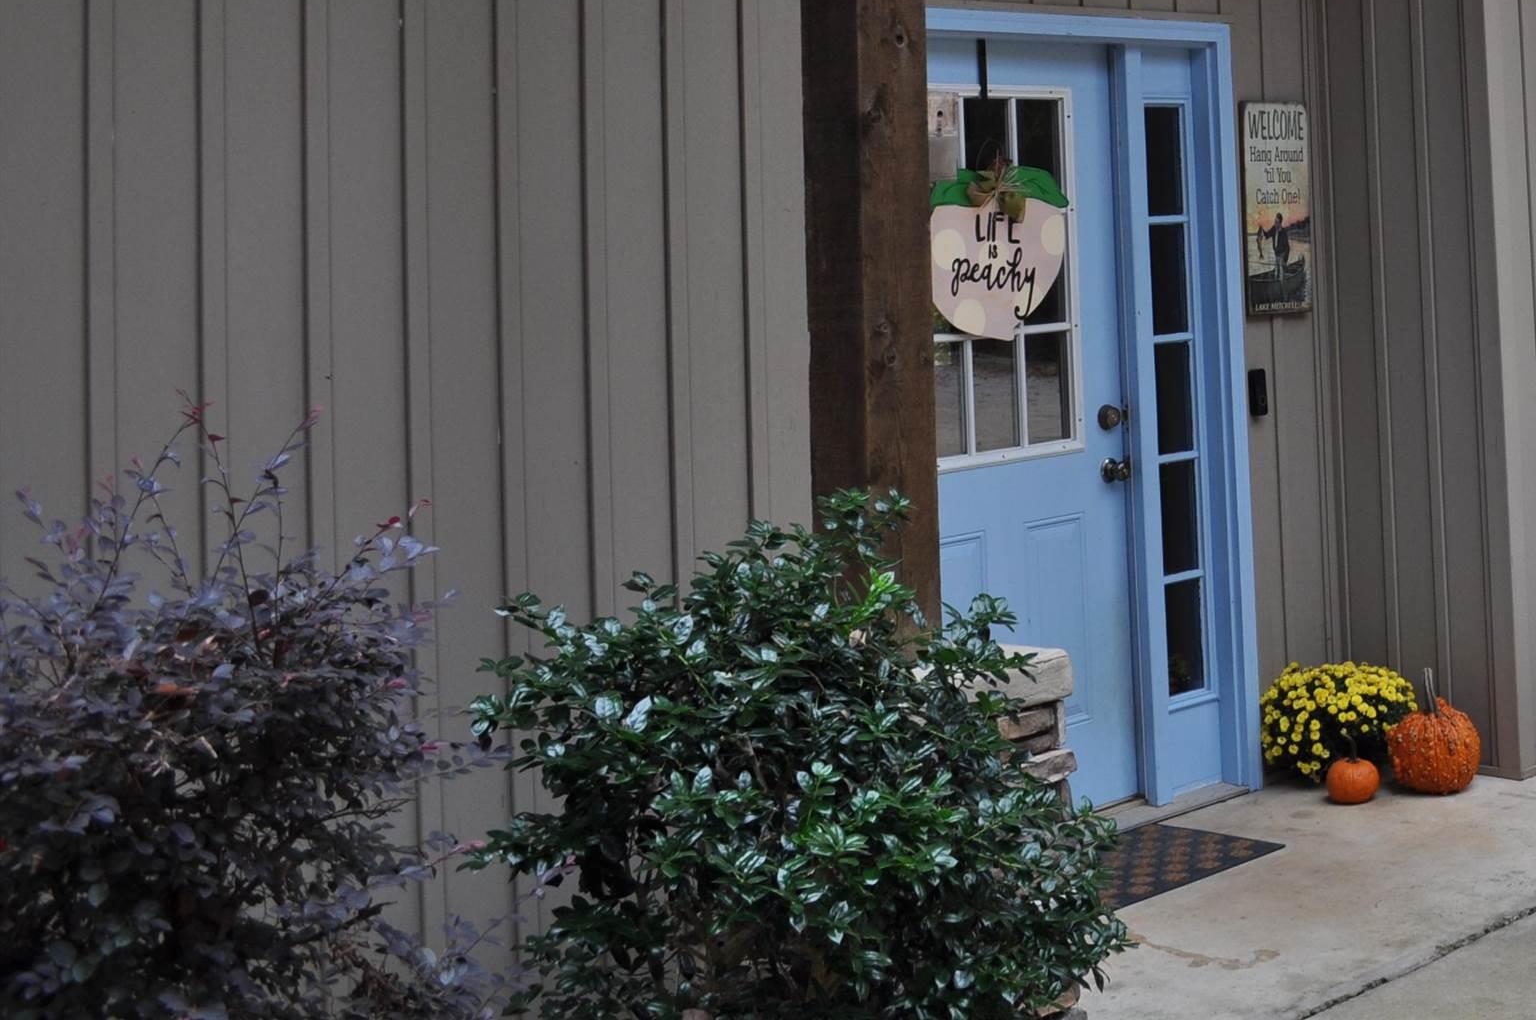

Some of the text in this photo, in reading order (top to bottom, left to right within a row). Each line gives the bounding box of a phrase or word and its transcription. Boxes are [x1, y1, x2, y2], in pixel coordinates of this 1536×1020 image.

[1248, 109, 1304, 140] WELCOME
[1249, 146, 1304, 166] Hang Around
[1276, 167, 1292, 183] You
[1256, 188, 1301, 204] Catch One!
[975, 212, 1022, 243] LIFE
[951, 247, 1036, 320] peachy
